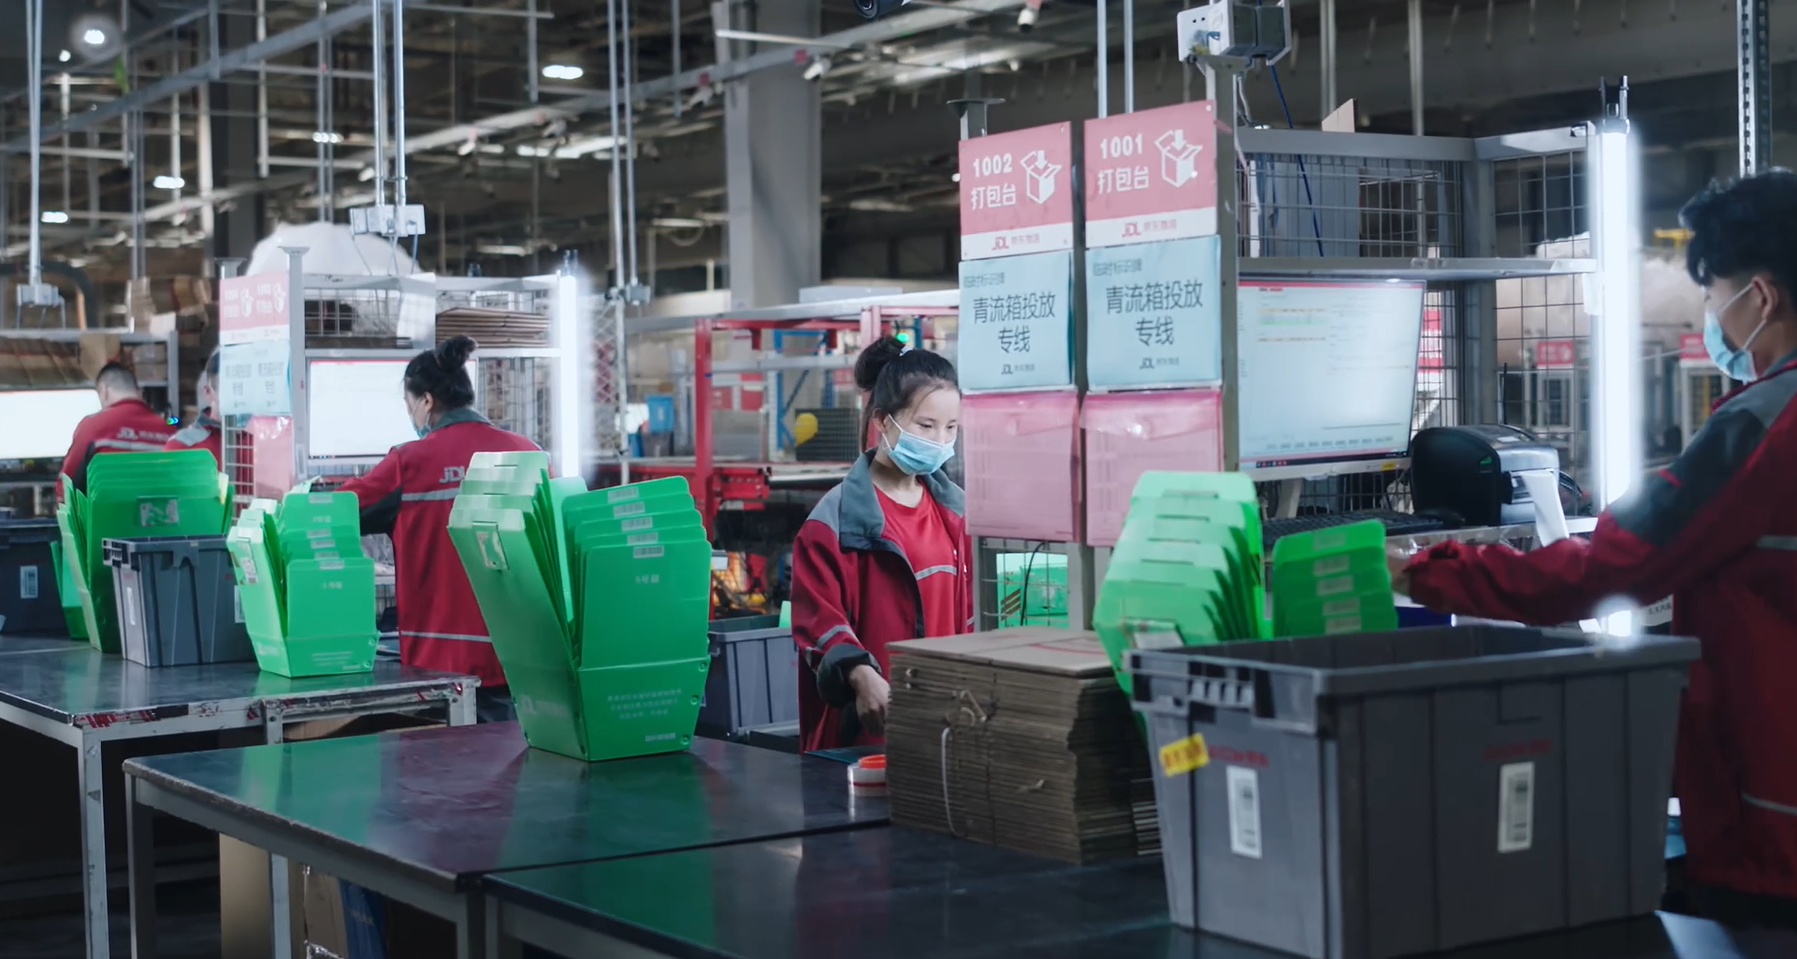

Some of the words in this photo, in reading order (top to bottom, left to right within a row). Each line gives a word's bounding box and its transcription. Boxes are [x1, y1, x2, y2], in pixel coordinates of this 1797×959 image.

[1100, 133, 1143, 159] 1001
[973, 153, 1013, 178] 1002
[1097, 165, 1149, 194] 打包台
[971, 183, 1016, 211] 打包台
[992, 236, 1009, 251] JDL
[1121, 221, 1142, 238] JDL
[973, 291, 1056, 324] 青流箱投放
[1106, 279, 1203, 315] 青流箱投放
[998, 326, 1031, 354] 专线
[1135, 316, 1174, 347] 专线
